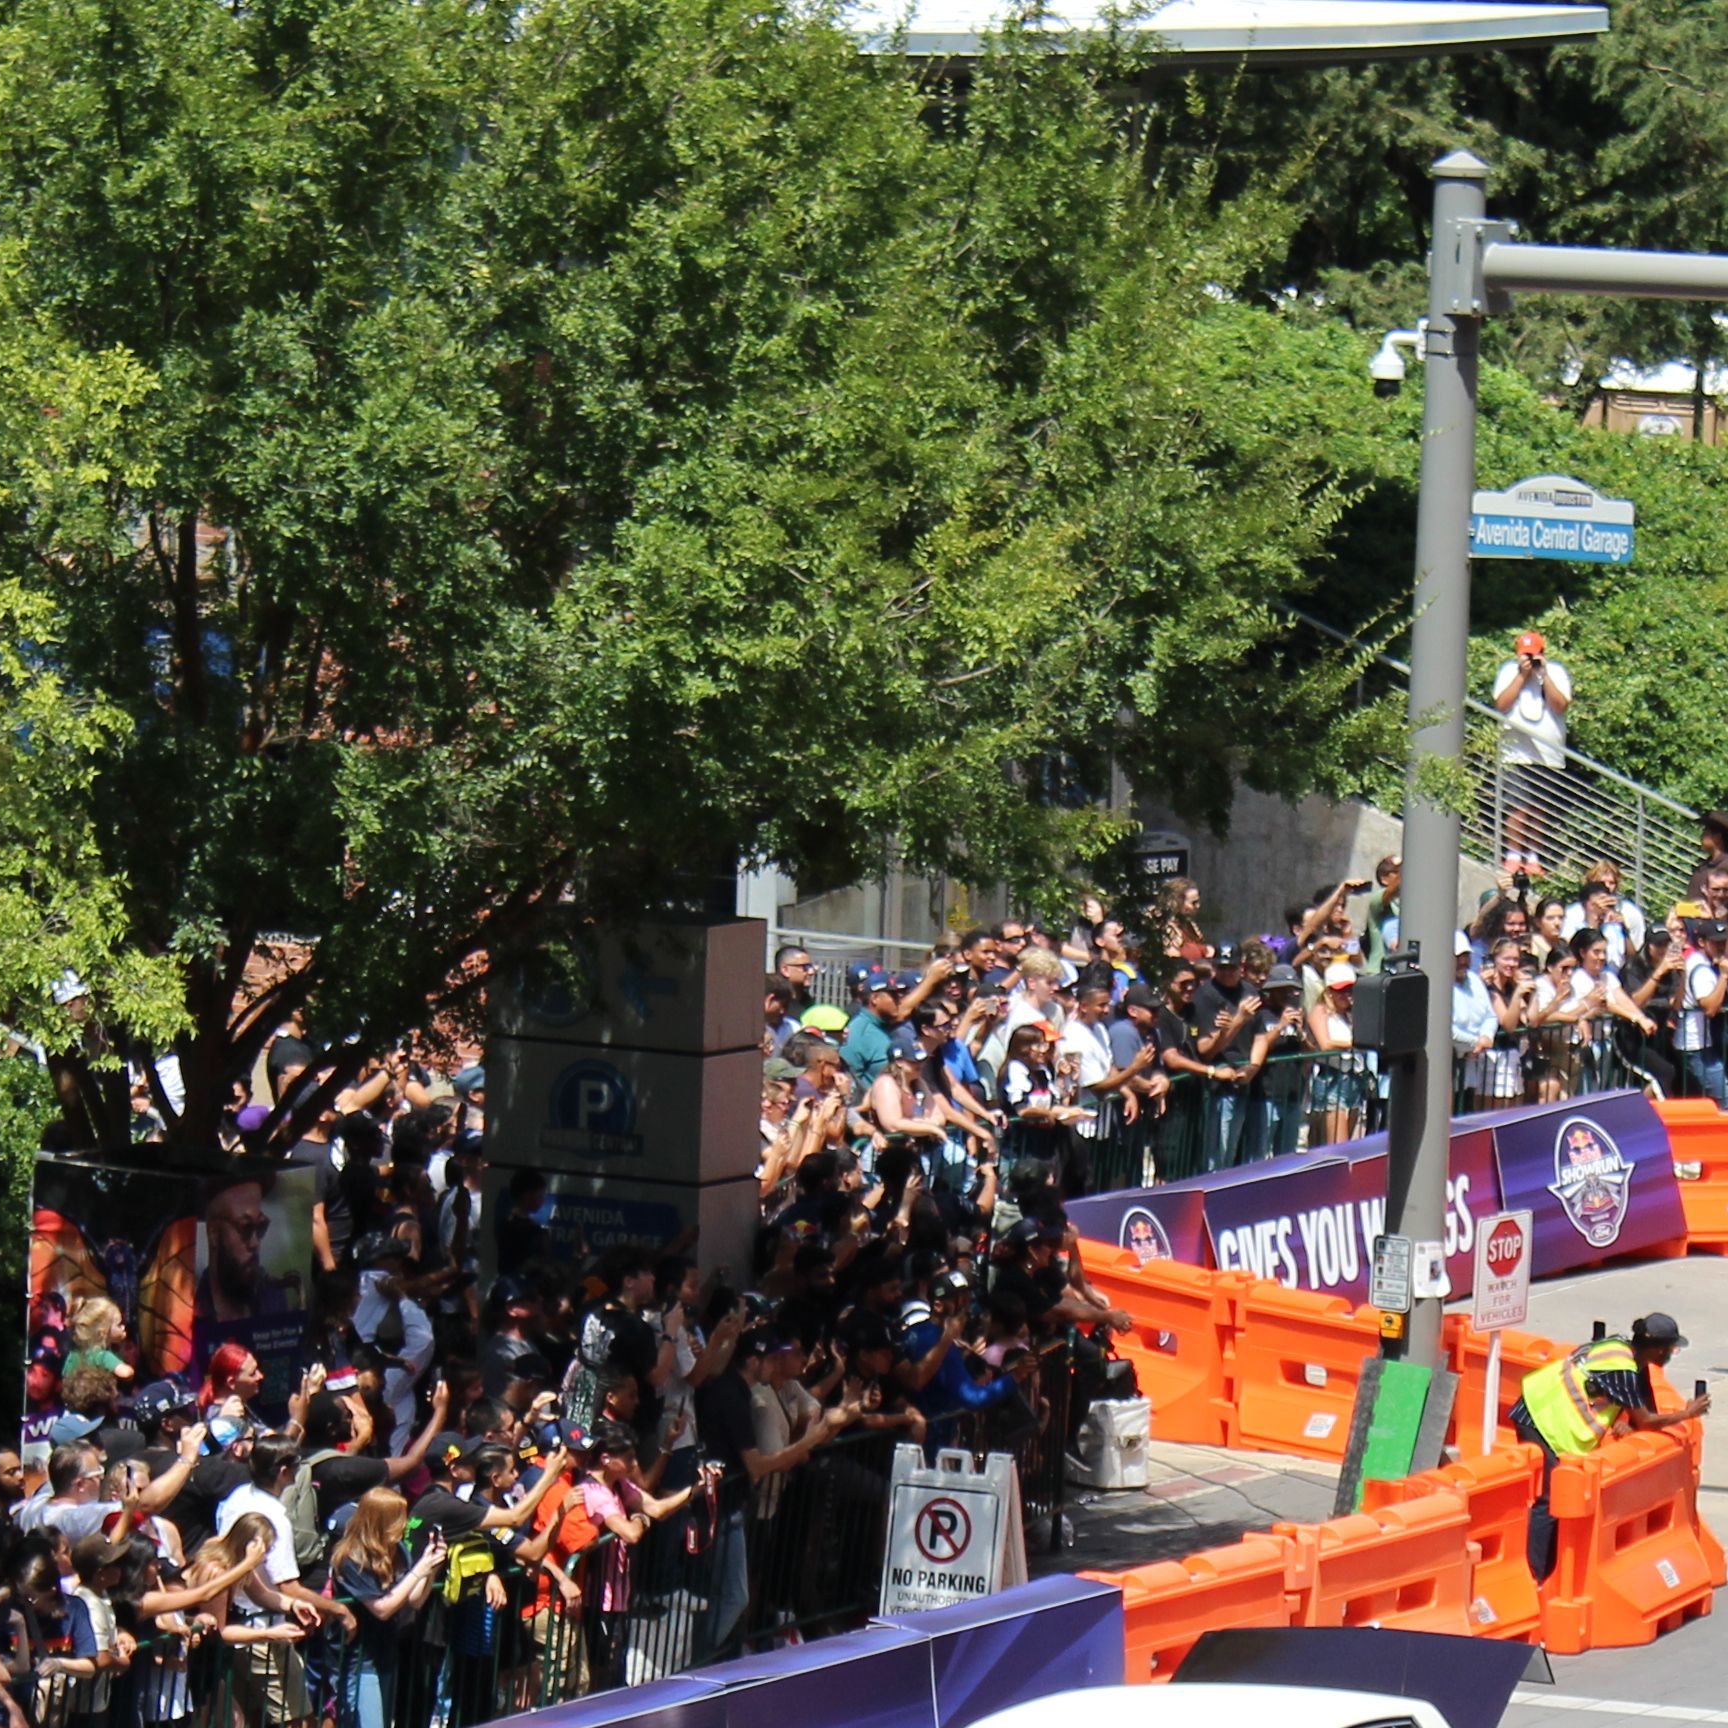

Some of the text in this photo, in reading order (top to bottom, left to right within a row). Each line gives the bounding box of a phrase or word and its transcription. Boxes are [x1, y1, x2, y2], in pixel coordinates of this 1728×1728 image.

[1477, 517, 1629, 560] Avenida Central Garage
[1561, 1157, 1619, 1185] SHOWRUN
[550, 1204, 625, 1226] AVENIDA
[1218, 1216, 1298, 1290] GIVES
[1297, 1203, 1360, 1290] YOU
[1488, 1235, 1521, 1263] STOP
[1493, 1293, 1510, 1307] FOR
[1480, 1306, 1523, 1325] VEHICLES
[891, 1567, 986, 1594] NO PARKING
